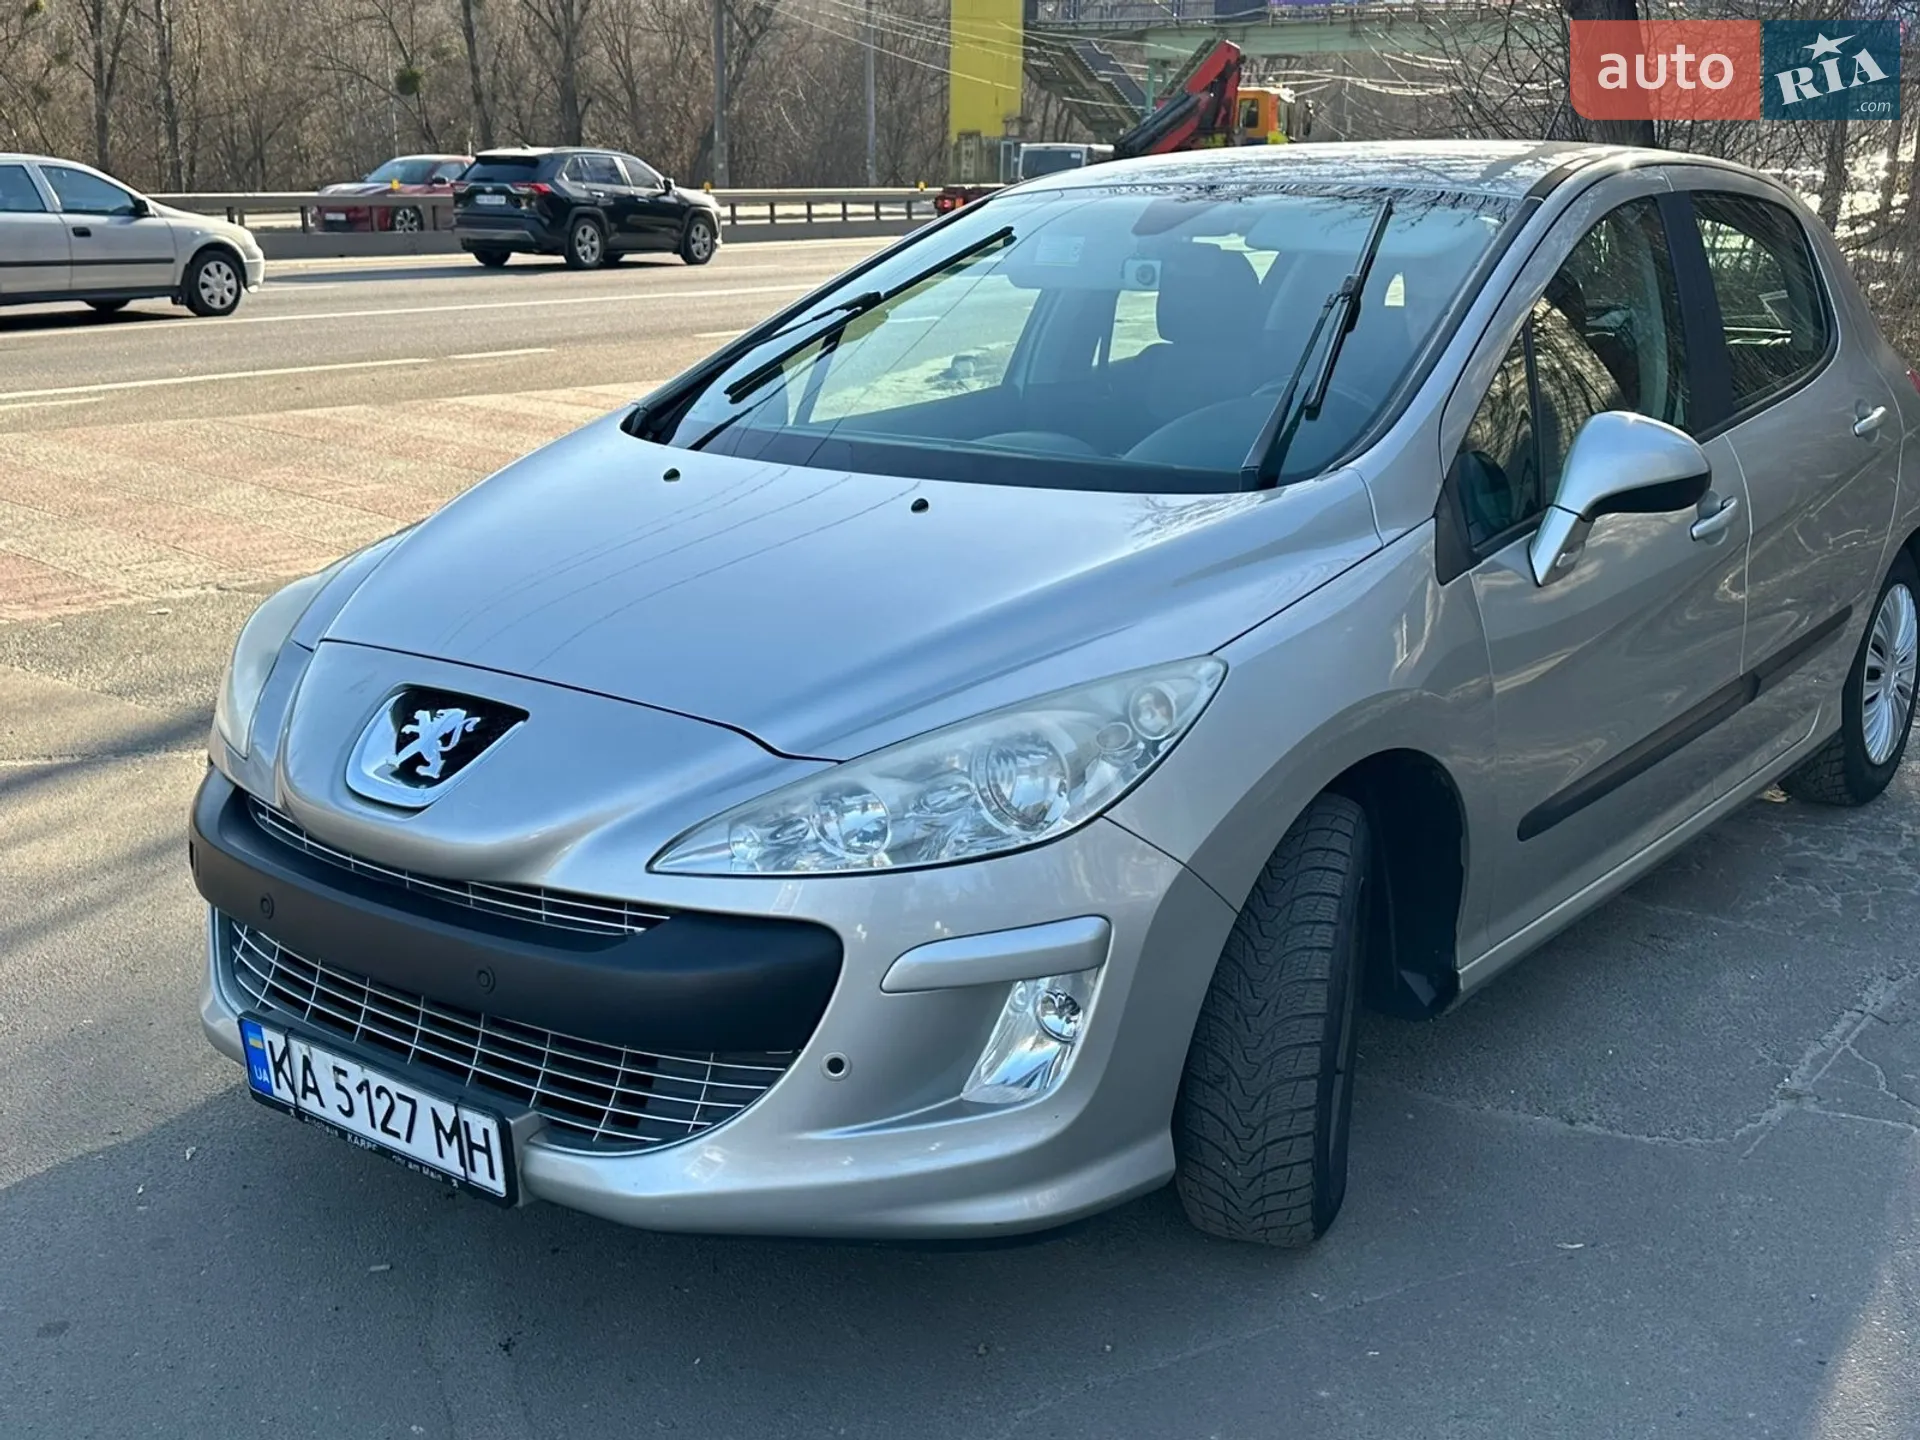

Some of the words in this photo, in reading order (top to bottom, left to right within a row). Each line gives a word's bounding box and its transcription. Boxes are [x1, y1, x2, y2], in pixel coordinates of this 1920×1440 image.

[253, 1065, 270, 1084] UA
[267, 1040, 325, 1108] KA
[332, 1065, 418, 1143] 5127
[431, 1106, 497, 1181] MH
